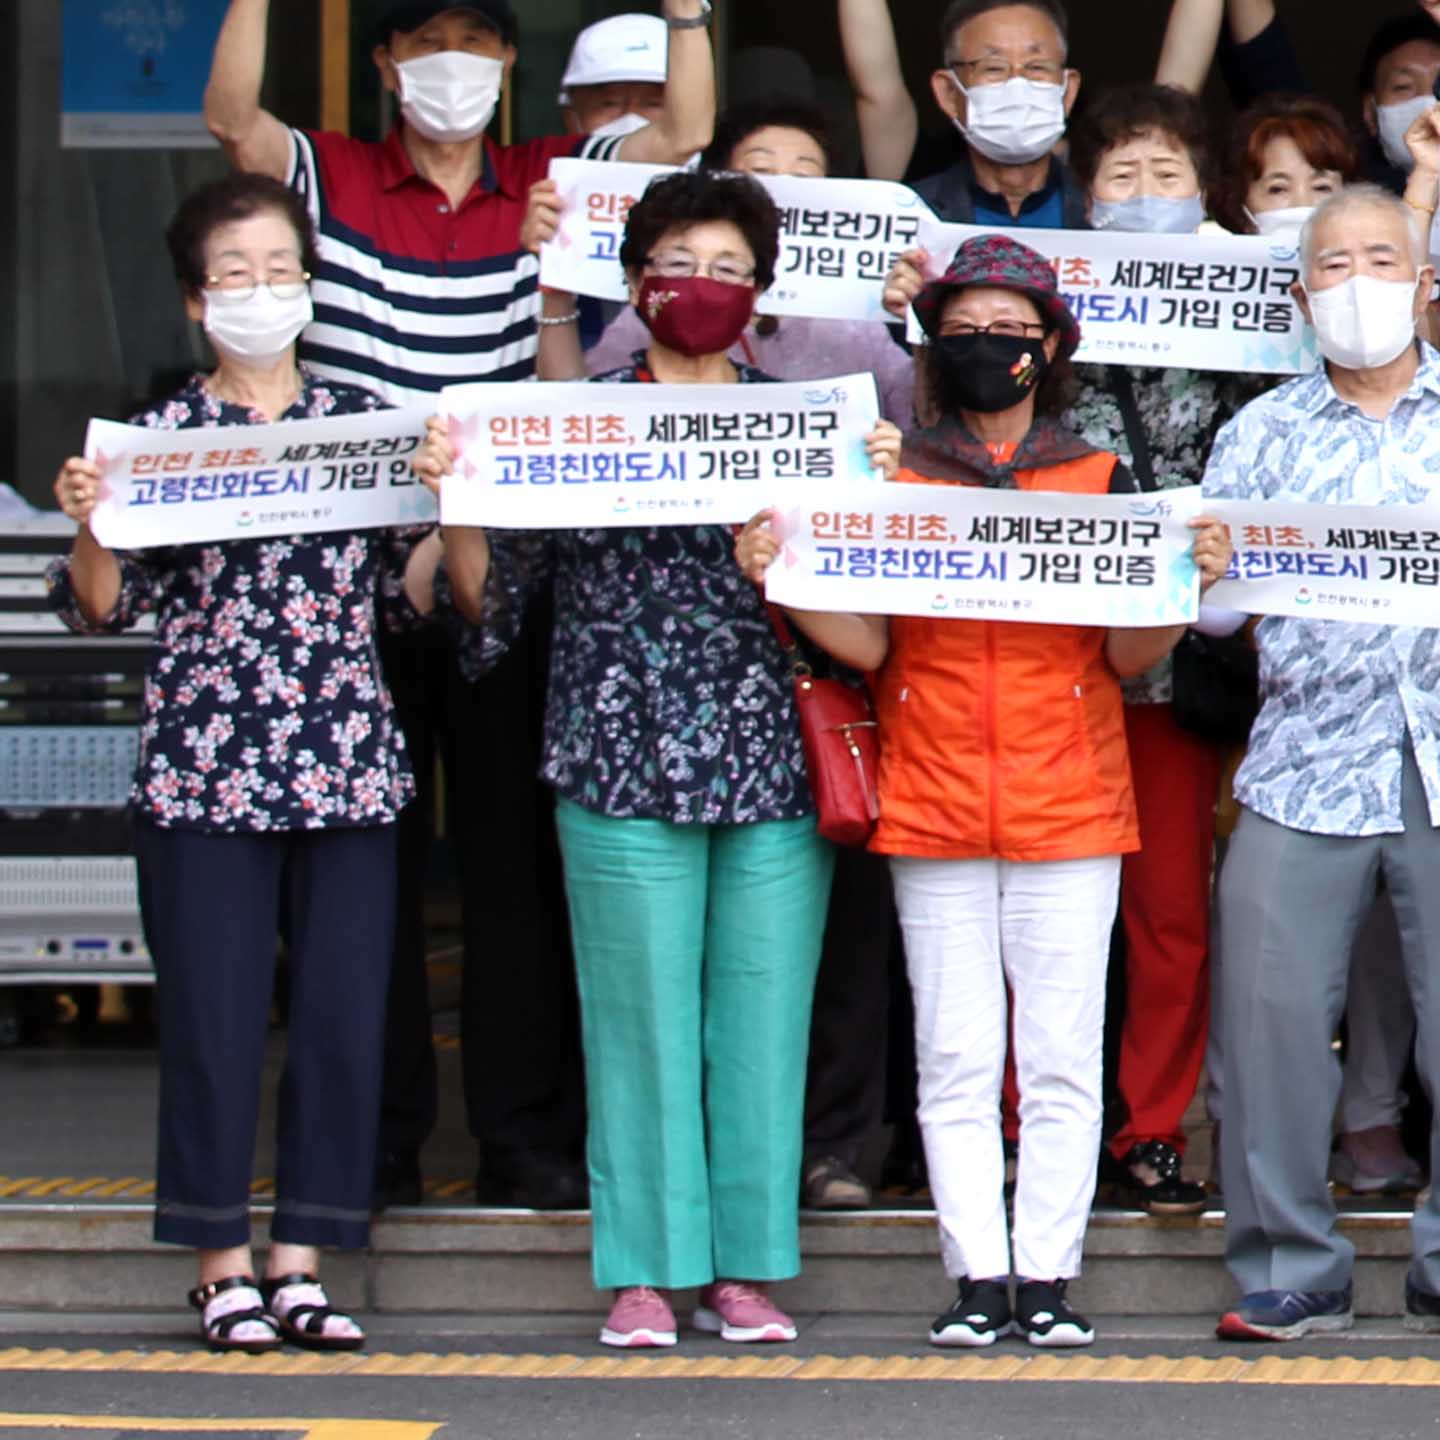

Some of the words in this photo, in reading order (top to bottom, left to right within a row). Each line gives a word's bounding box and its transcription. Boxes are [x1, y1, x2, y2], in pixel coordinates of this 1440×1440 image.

[489, 416, 551, 446] 인천
[564, 415, 635, 445] 최초,
[645, 411, 839, 443] 세계보건기구
[495, 451, 686, 485] 고령친화도시
[698, 449, 760, 480] 가입
[772, 448, 834, 478] 인증
[811, 512, 873, 540] 인천
[885, 514, 957, 544] 최초,
[966, 516, 1162, 548] 세계보건기구
[815, 546, 1007, 581] 고령친화도시
[1019, 552, 1081, 584] 가입
[1093, 554, 1155, 586] 인증
